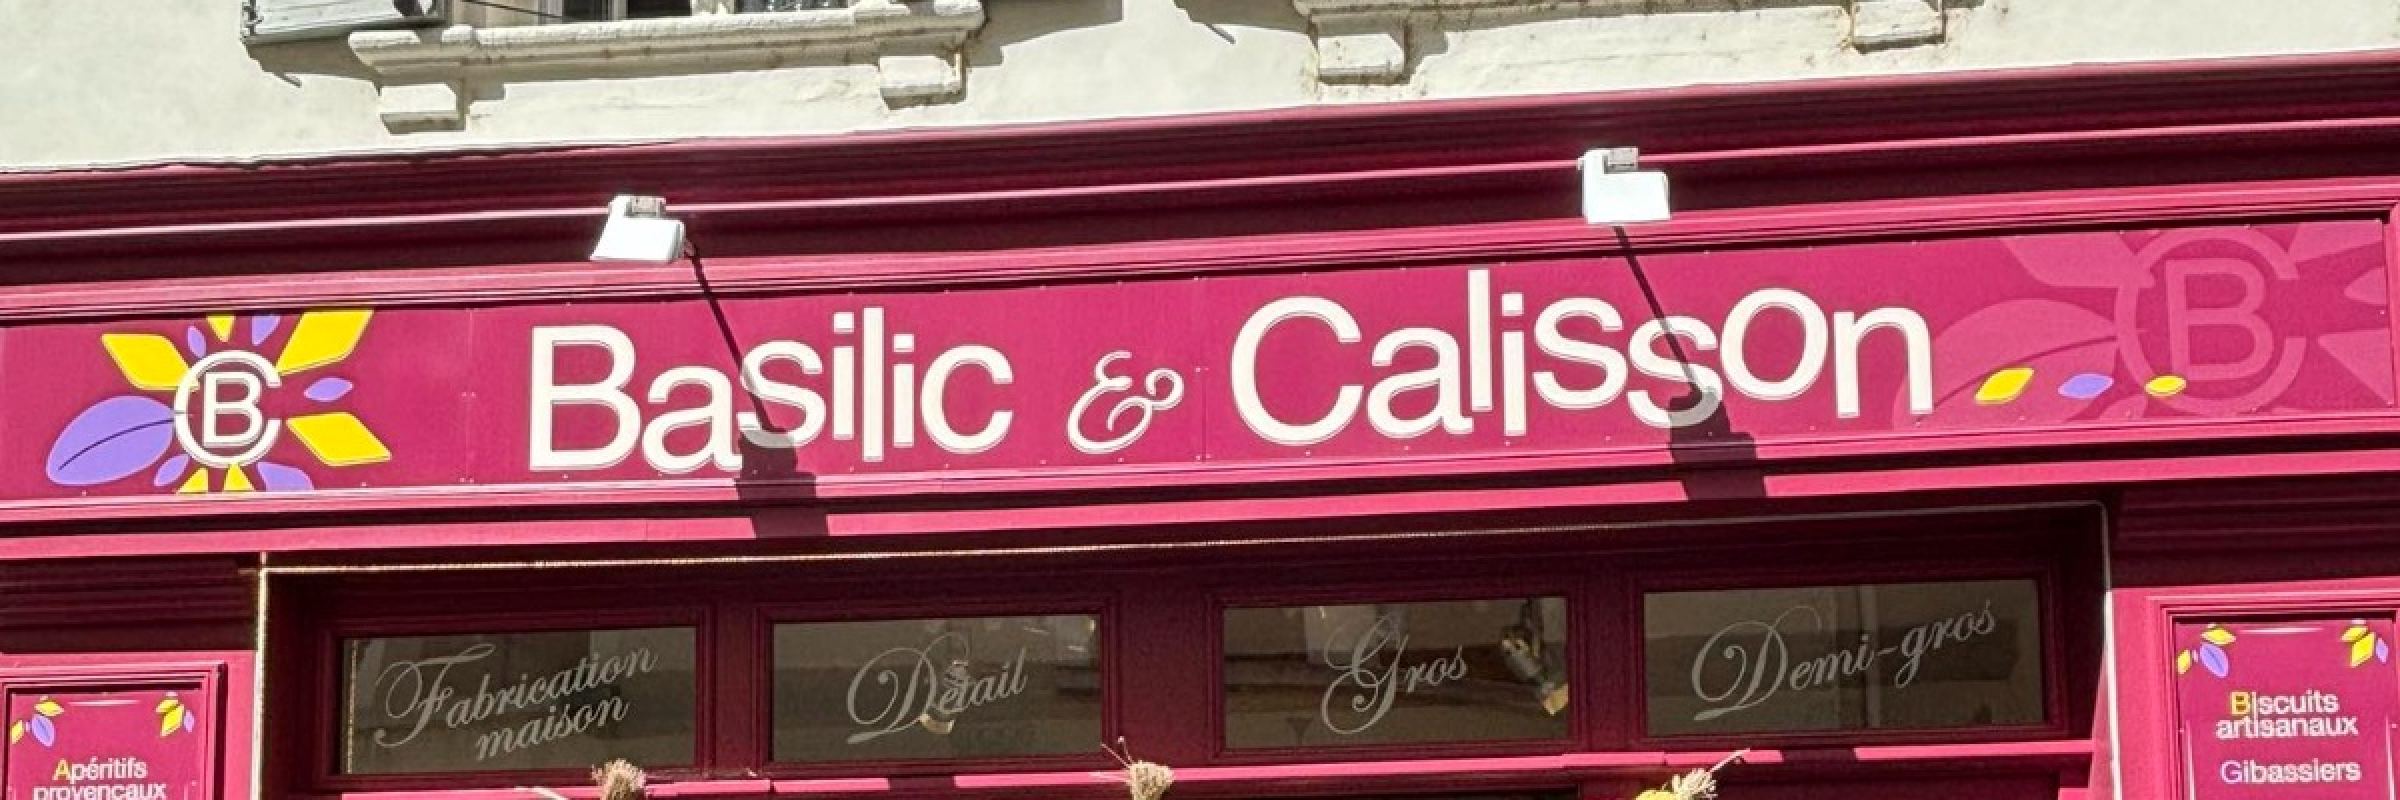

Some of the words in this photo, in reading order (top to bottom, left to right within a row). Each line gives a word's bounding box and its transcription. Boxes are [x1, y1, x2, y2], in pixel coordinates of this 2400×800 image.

[528, 306, 1015, 474] Basilic
[1066, 350, 1184, 454] &
[1230, 267, 1934, 447] Calisson
[1321, 611, 1468, 735] Gros
[1691, 598, 1996, 721] Demi-gros
[373, 642, 660, 748] Fabrication
[474, 694, 630, 761] maison
[2216, 713, 2359, 740] artisanaux
[2229, 688, 2340, 717] Biscuits
[52, 756, 149, 785] Apéritifs
[2220, 758, 2362, 784] Gibassiers
